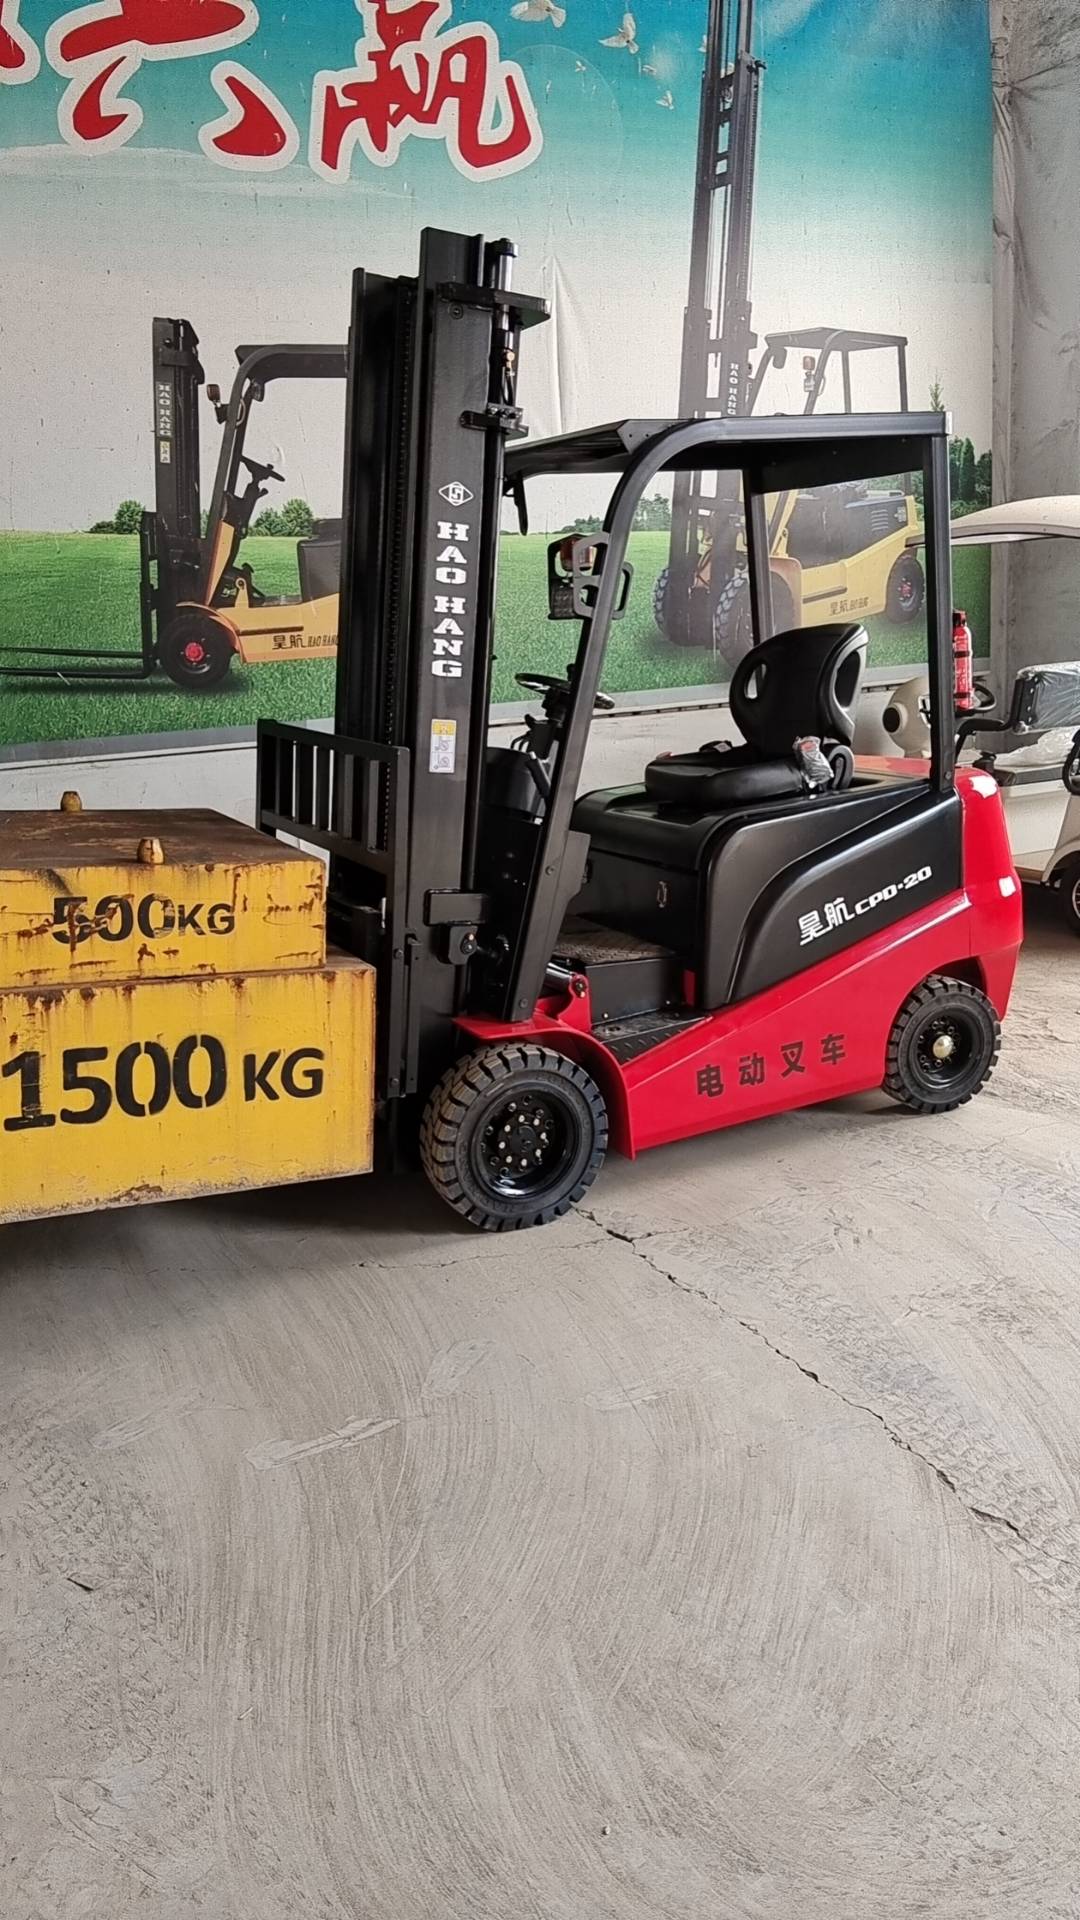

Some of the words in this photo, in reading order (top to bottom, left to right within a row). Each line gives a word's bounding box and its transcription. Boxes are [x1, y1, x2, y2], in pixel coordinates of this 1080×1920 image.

[729, 363, 739, 384] HAO
[159, 384, 171, 406] HAO
[727, 387, 738, 415] HANG
[159, 408, 172, 436] HANG
[435, 520, 470, 585] HAO
[272, 634, 308, 650] 昊航
[431, 595, 466, 678] HANG
[798, 896, 855, 946] 昊航
[1, 1033, 228, 1133] 1500
[242, 1047, 325, 1102] KG
[696, 1033, 847, 1098] 电动叉车
